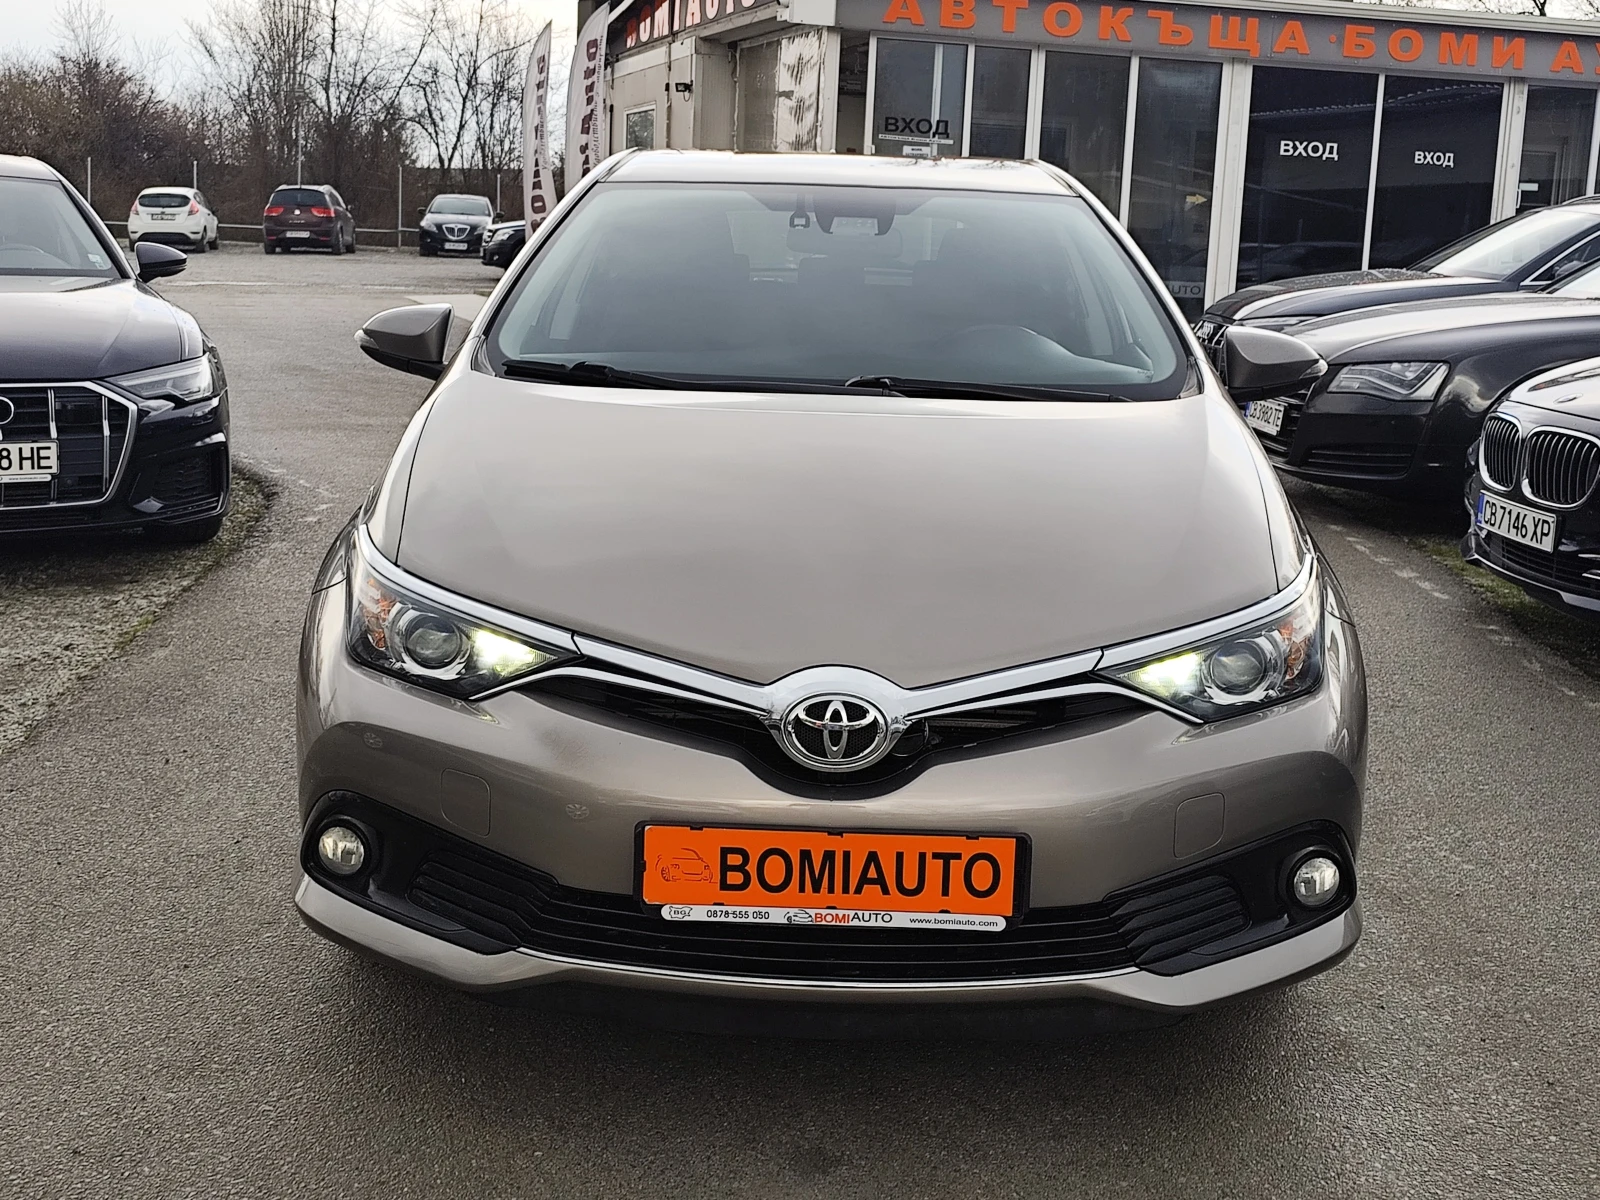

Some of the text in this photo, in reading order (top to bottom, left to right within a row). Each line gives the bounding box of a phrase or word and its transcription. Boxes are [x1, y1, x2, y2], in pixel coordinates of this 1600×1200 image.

[625, 0, 756, 49] BOMIA
[882, 0, 1600, 75] АВТОКЪЩА БОМИ А
[884, 116, 950, 138] ВХОД
[1279, 140, 1339, 161] ВХОД
[1414, 151, 1454, 168] ВХОД
[1167, 284, 1201, 296] UTO
[18, 446, 53, 471] HE
[719, 846, 1002, 898] BOMIAUTO
[706, 909, 770, 920] 0878 555 050
[909, 916, 998, 928] www.bomiauto.com
